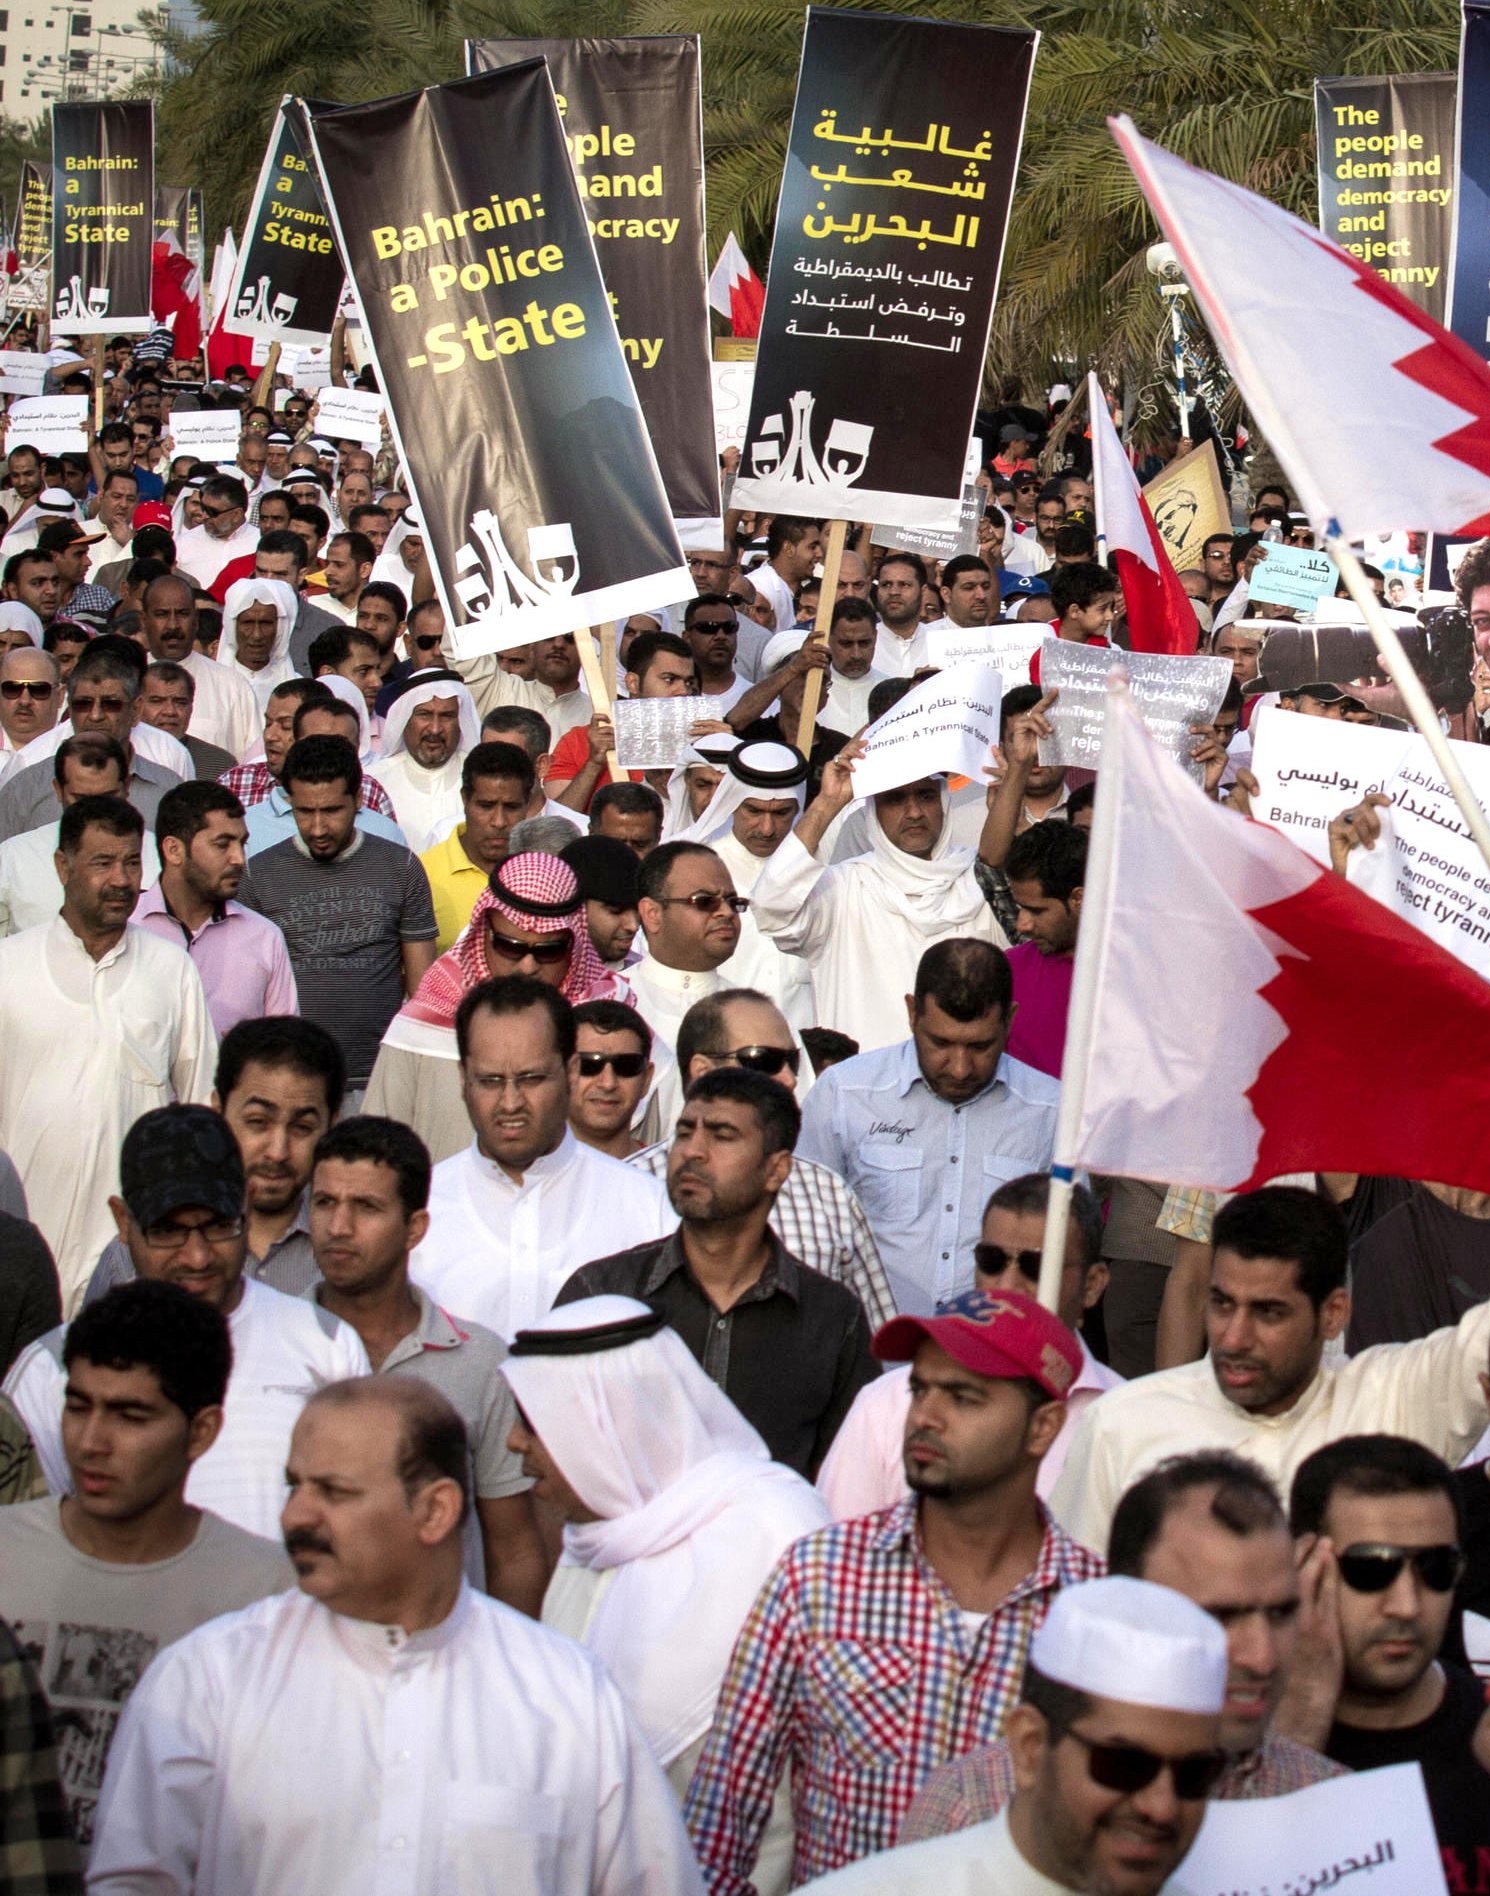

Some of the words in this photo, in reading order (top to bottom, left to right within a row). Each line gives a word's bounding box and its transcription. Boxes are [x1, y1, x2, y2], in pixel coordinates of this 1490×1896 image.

[1333, 105, 1380, 126] The
[565, 125, 636, 165] ple
[813, 109, 992, 160] غالبية
[1335, 129, 1424, 158] people
[65, 155, 138, 171] Bahrain:
[1336, 155, 1441, 180] demand
[65, 178, 79, 194] a
[276, 176, 293, 193] a
[810, 162, 986, 200] شعب
[24, 201, 52, 212] dema
[26, 192, 52, 203] peop
[1336, 188, 1452, 207] democracy
[65, 203, 144, 219] Tyrannical
[271, 201, 329, 226] Tyrann
[1338, 210, 1385, 232] and
[65, 224, 130, 243] State
[153, 218, 180, 228] rain:
[371, 193, 547, 259] Bahrain:
[587, 218, 680, 245] cracy
[802, 201, 980, 251] البحرين
[18, 243, 51, 254] tyrann
[263, 222, 333, 254] State
[390, 284, 419, 313] a
[428, 244, 564, 302] Police
[793, 257, 903, 283] بالديمقراطية
[907, 267, 974, 292] تطالب
[1376, 266, 1440, 287] anny
[791, 289, 875, 311] استبداد
[878, 298, 966, 326] وترفض
[407, 300, 587, 374] -State
[785, 322, 962, 354] السلطة
[895, 531, 922, 544] reject
[923, 535, 959, 550] tyranny
[928, 697, 957, 714] نظام
[1072, 705, 1096, 717] The
[912, 730, 920, 739] A
[1072, 736, 1100, 753] reje
[1151, 733, 1173, 744] nd
[1277, 769, 1359, 794] بوليسي
[1270, 807, 1328, 830] Bahrai
[1393, 835, 1417, 857] The
[1418, 850, 1471, 882] people
